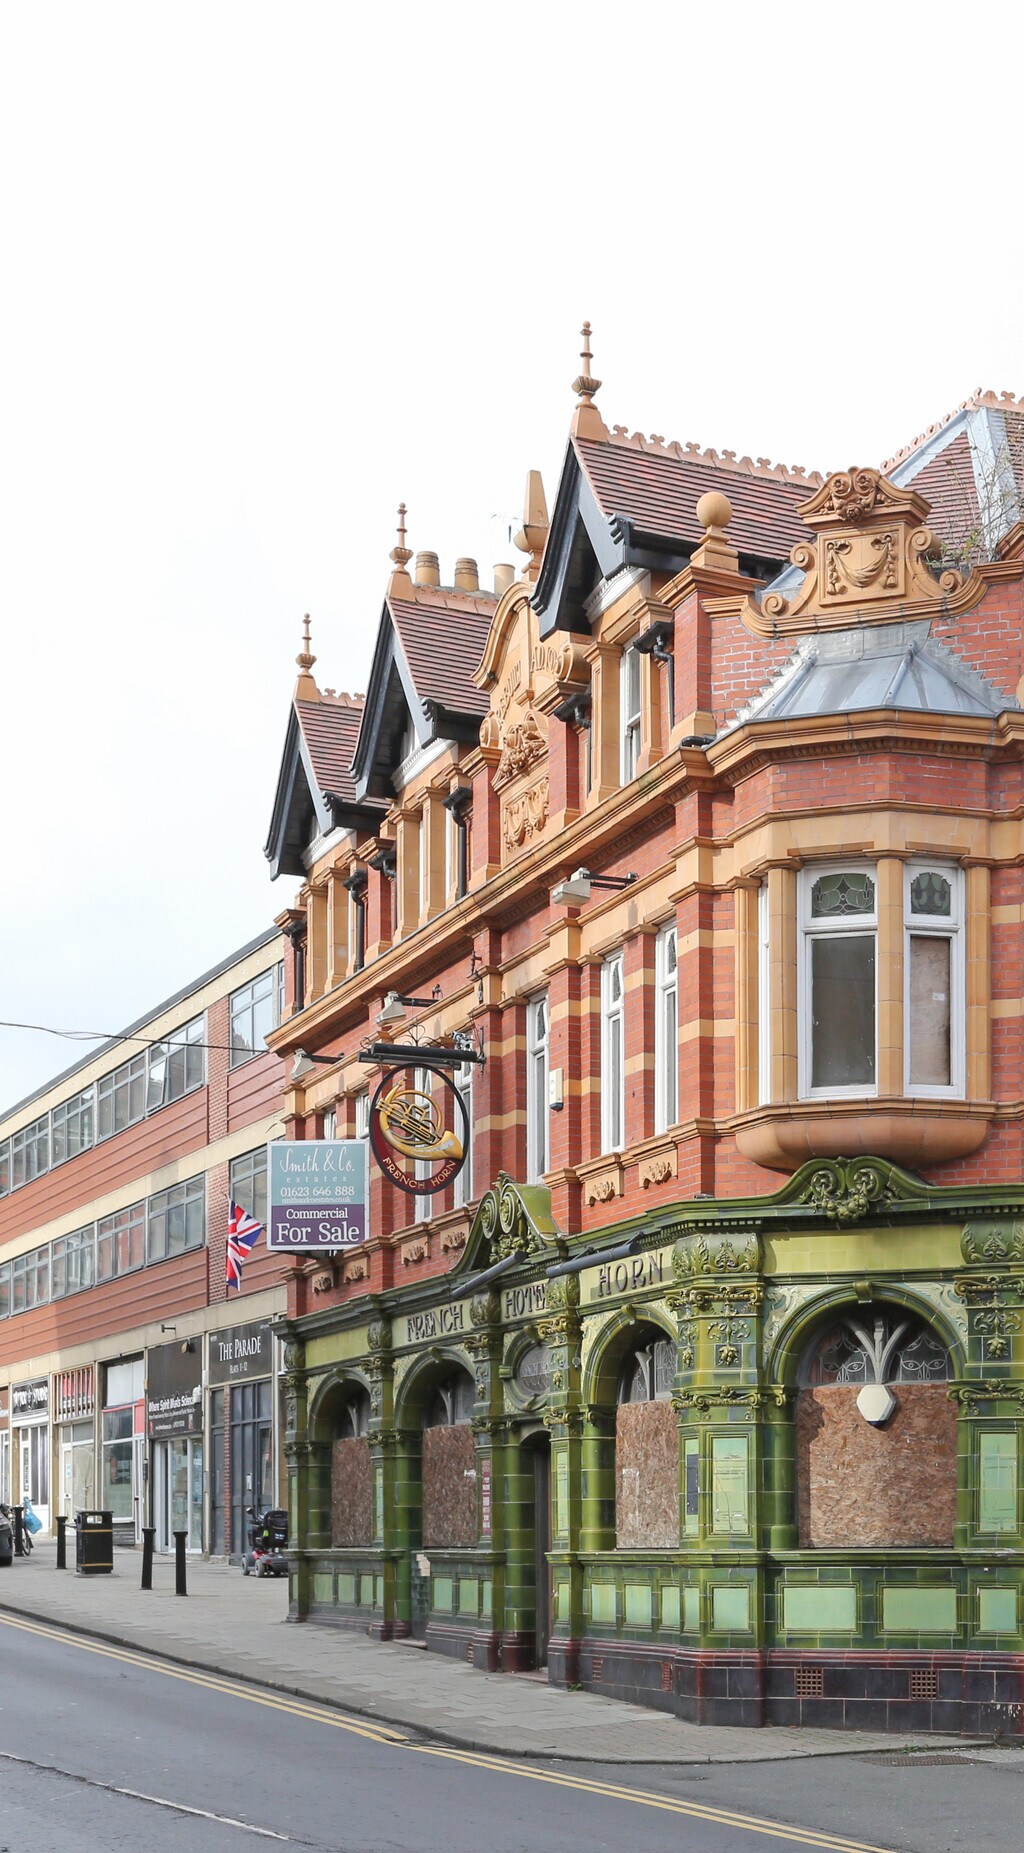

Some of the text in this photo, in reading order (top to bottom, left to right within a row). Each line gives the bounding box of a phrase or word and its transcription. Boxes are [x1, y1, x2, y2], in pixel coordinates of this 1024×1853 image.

[280, 1146, 355, 1172] Smith & Co.
[383, 1157, 456, 1189] FRENCH HORN
[280, 1185, 355, 1197] 01623 646 888
[286, 1207, 348, 1219] Commercial
[276, 1221, 360, 1243] For Sale
[407, 1252, 663, 1342] FRENCH HOTE HORN
